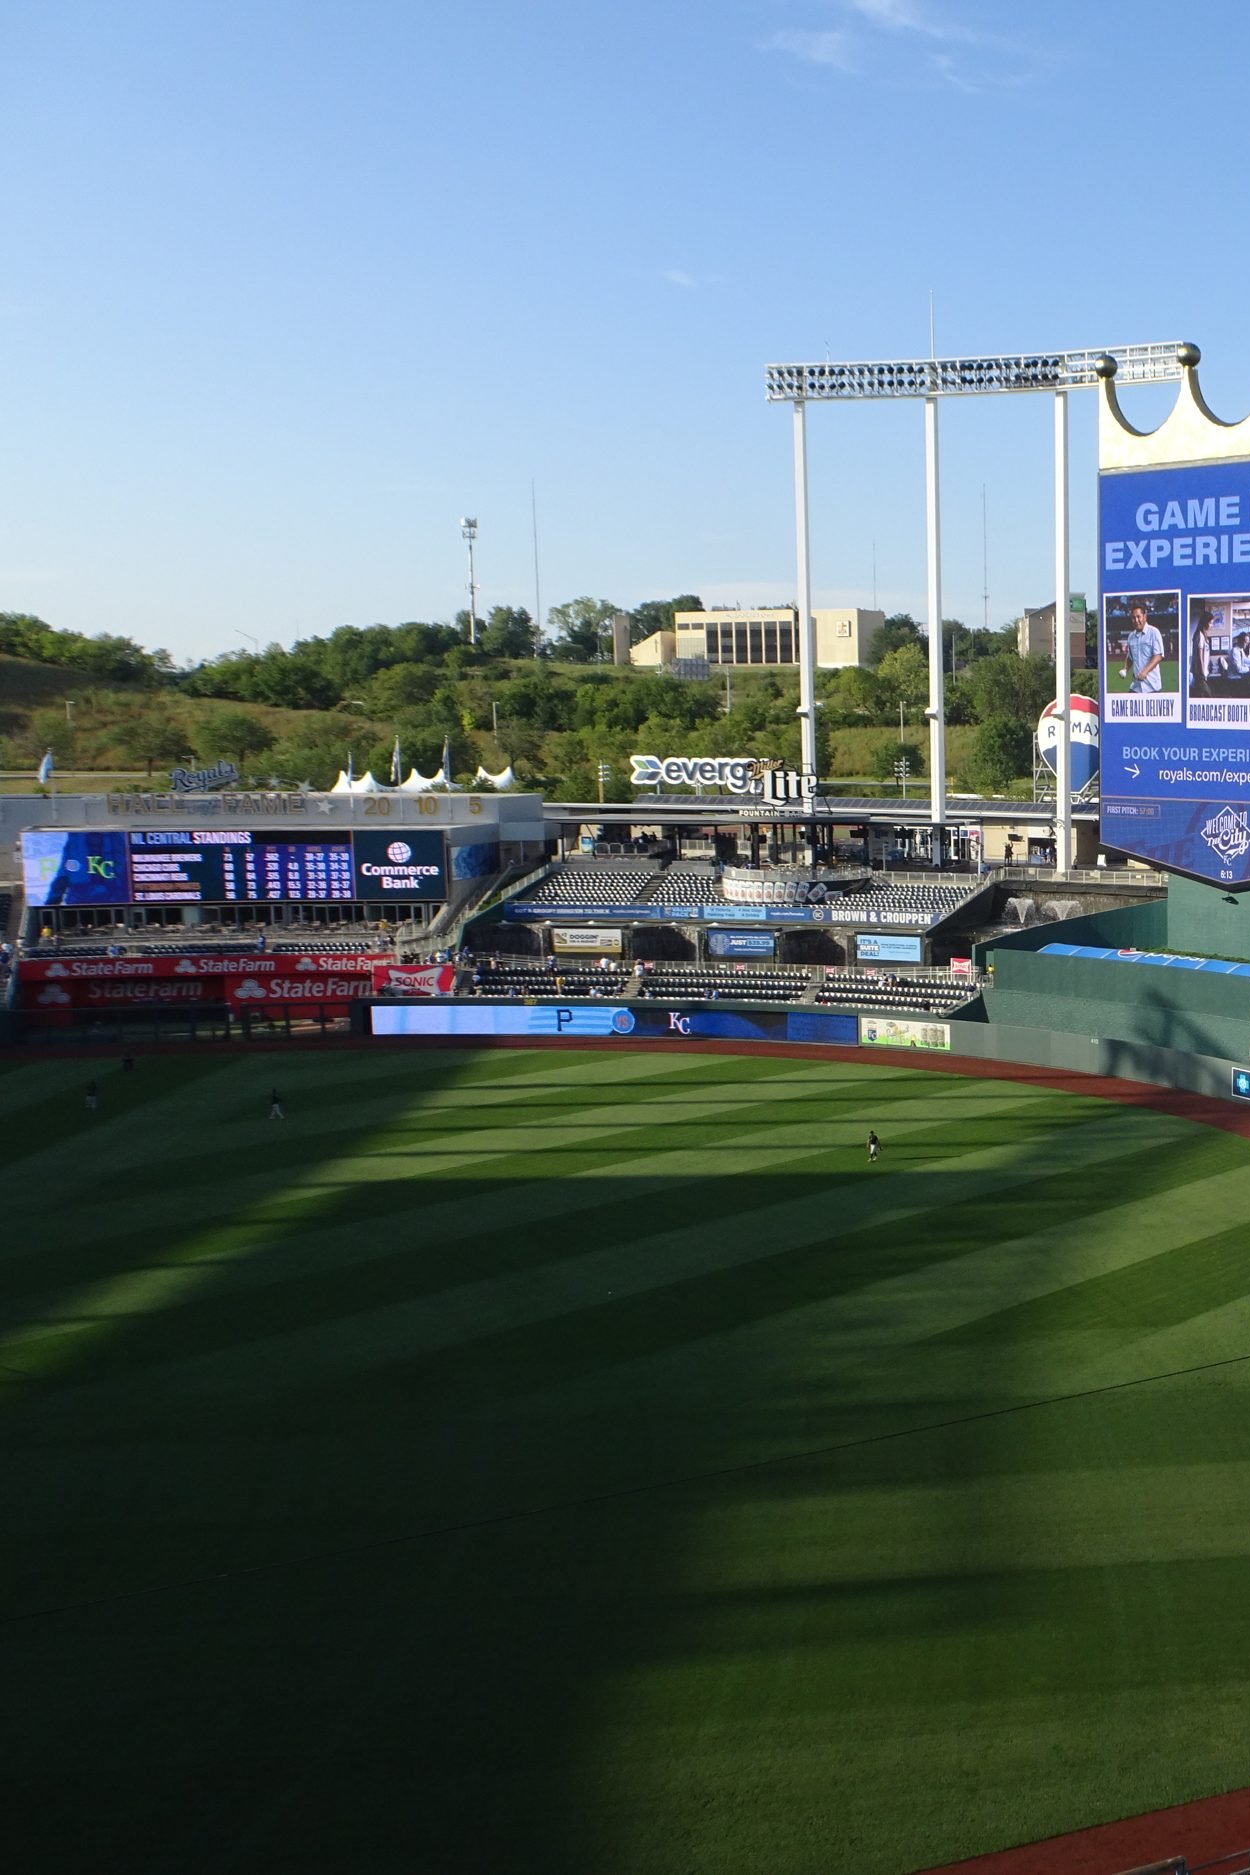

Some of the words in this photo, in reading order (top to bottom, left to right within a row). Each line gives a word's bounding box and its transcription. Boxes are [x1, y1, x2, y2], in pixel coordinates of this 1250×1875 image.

[1136, 495, 1240, 532] GAME
[1112, 700, 1128, 716] GAME
[1130, 700, 1144, 716] BALL
[1146, 699, 1174, 716] DELIVERY
[1190, 704, 1226, 722] BROADCAST
[1228, 705, 1248, 722] BOOTH
[1122, 747, 1159, 760] BOOK
[1162, 748, 1198, 761] YOUR
[168, 761, 240, 792] Royals
[664, 759, 767, 792] everg
[746, 759, 784, 779] Miller
[762, 770, 818, 806] Lite
[107, 793, 188, 816] HALL
[220, 793, 307, 816] FAME
[364, 797, 391, 816] 20
[414, 796, 438, 816] 10
[469, 796, 483, 815] 5
[1107, 806, 1121, 814] FIRST
[1206, 814, 1237, 836] WELCOME
[1239, 811, 1248, 828] TO
[130, 832, 146, 844] NL
[146, 832, 192, 844] CENTRAL
[192, 832, 251, 844] STANDINGS
[1218, 829, 1249, 854] City
[86, 856, 115, 879] KC
[362, 863, 439, 877] Commerce
[1220, 870, 1233, 879] 6:13
[381, 876, 420, 888] Bank
[832, 911, 866, 922] BROWN
[869, 912, 878, 923] &
[880, 912, 931, 924] CROUPPEN
[394, 976, 436, 987] SONIC
[556, 1009, 573, 1032] P
[616, 1015, 629, 1027] VS
[668, 1012, 691, 1034] KC
